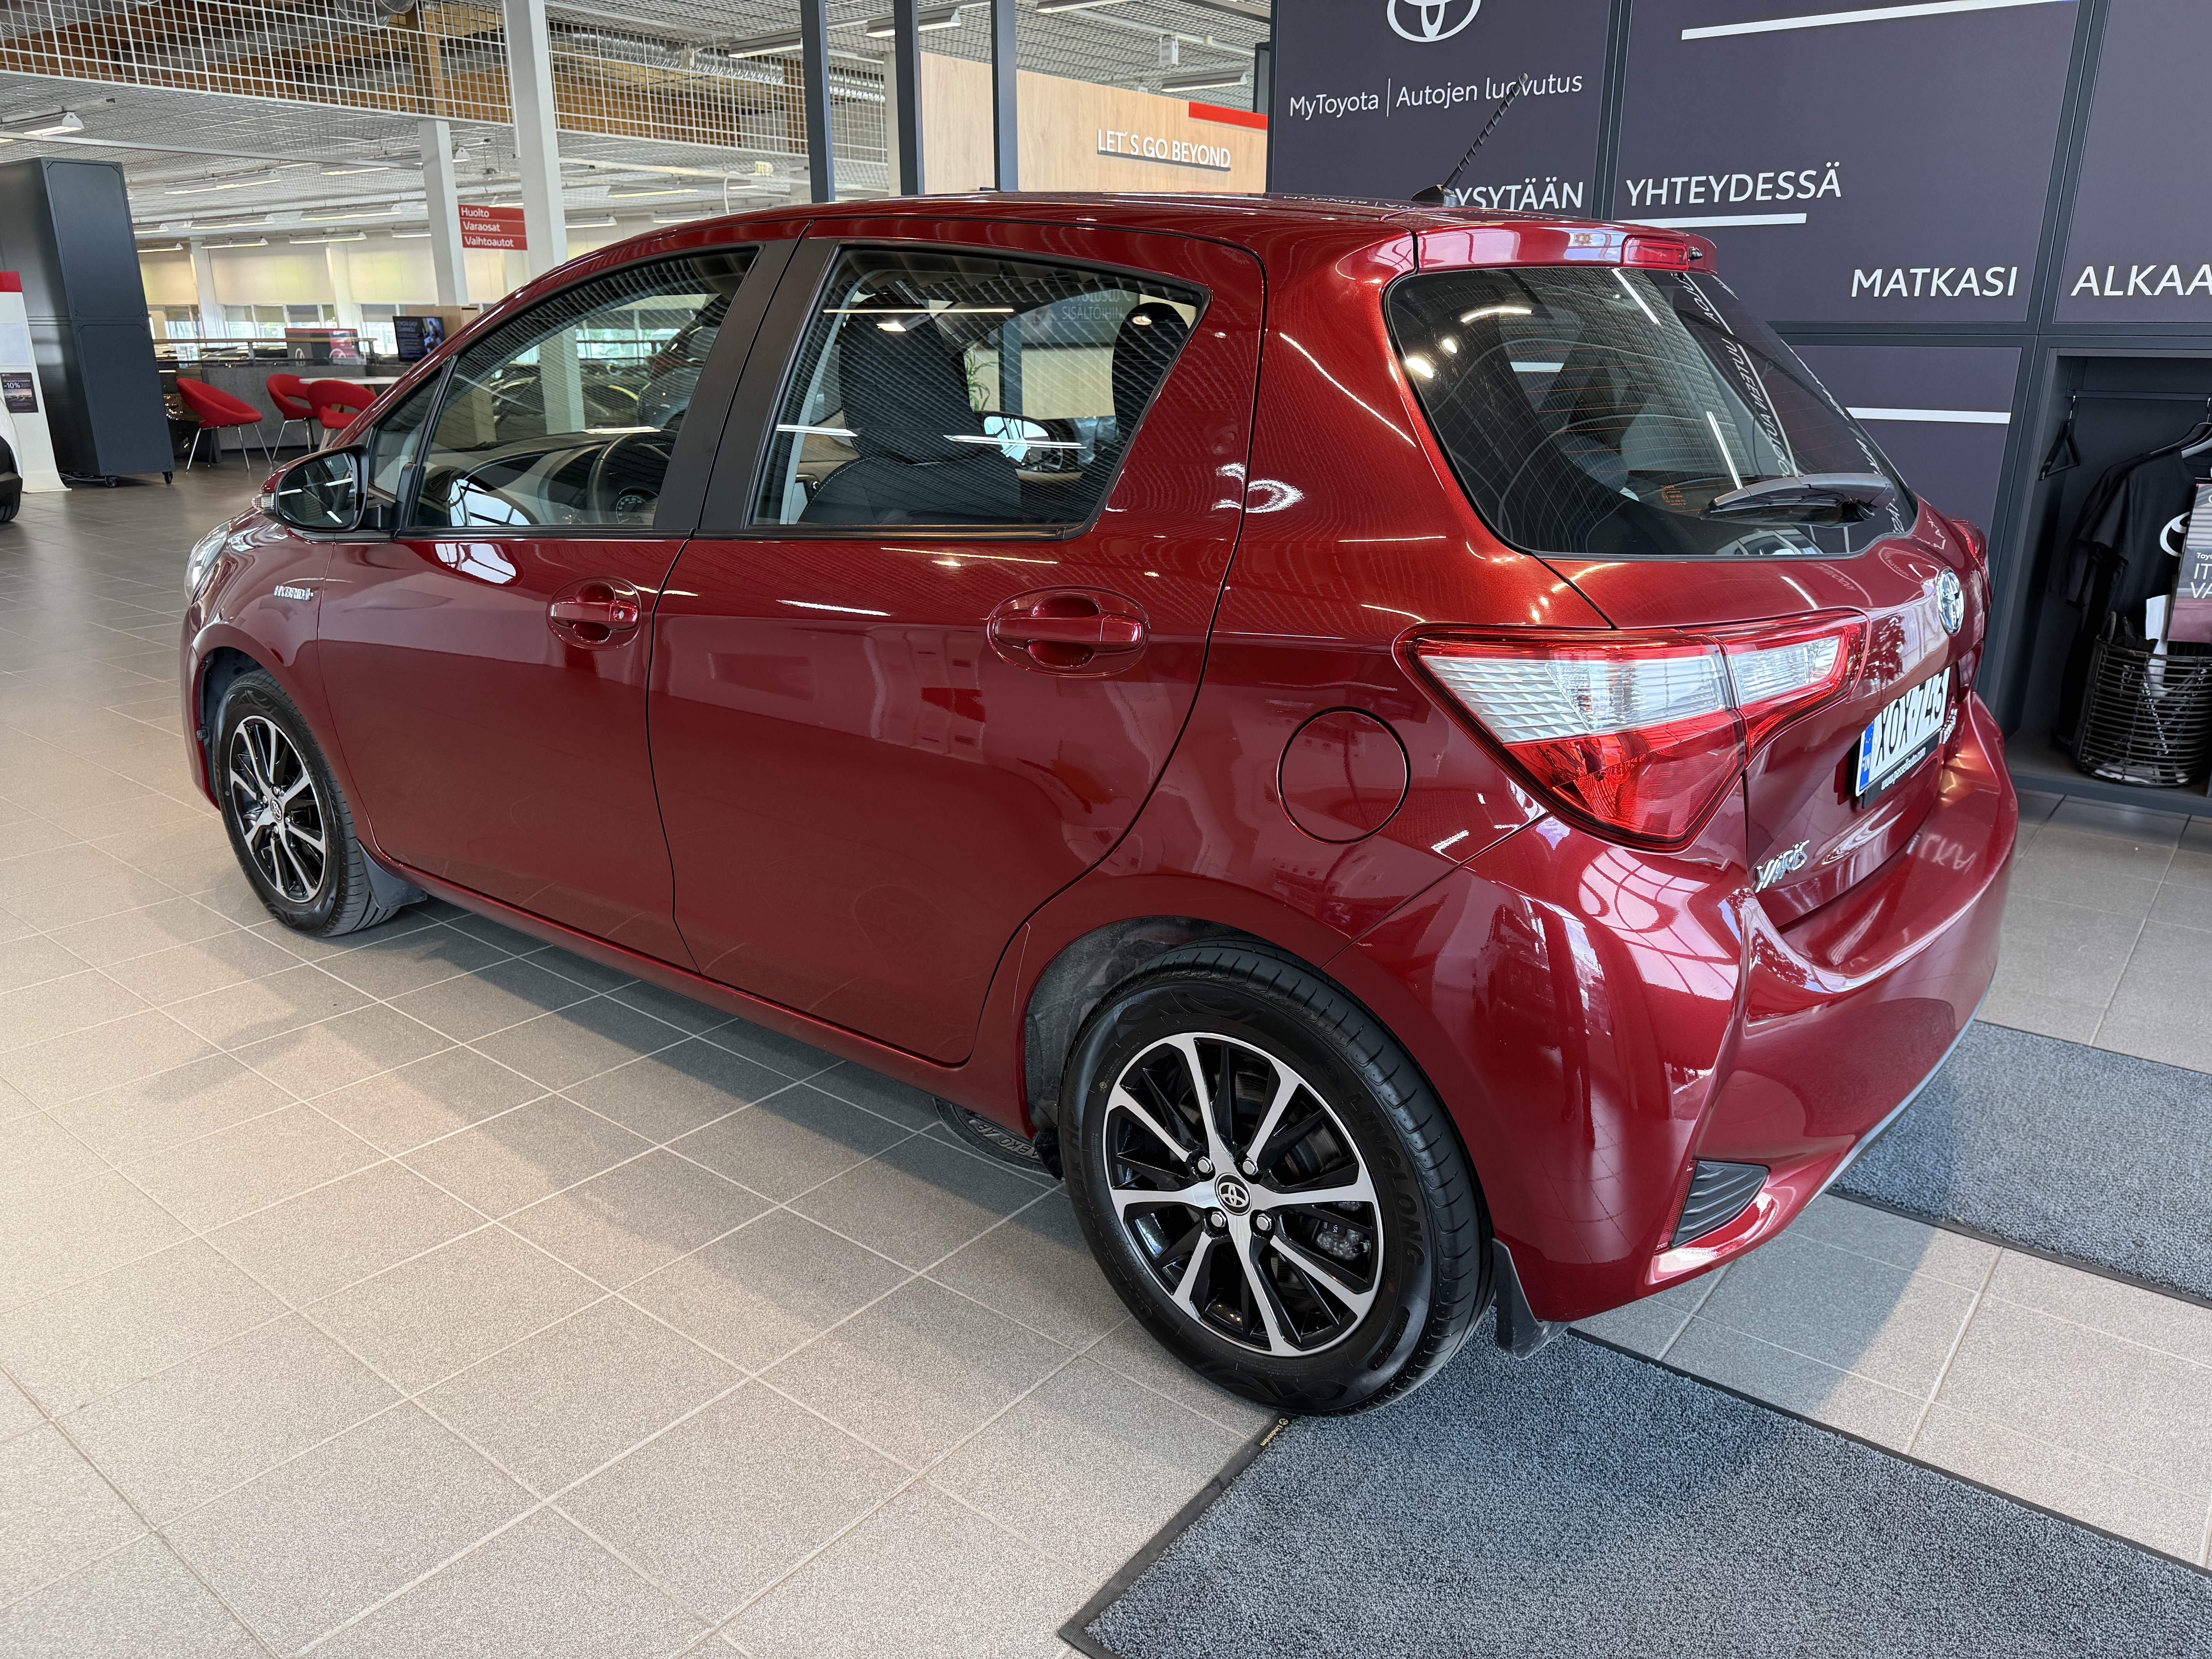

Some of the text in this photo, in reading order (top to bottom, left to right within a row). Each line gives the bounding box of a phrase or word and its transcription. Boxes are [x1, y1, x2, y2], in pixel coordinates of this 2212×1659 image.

[1290, 93, 1379, 120] MyToyota
[1396, 82, 1477, 108] Autojen
[1143, 137, 1168, 159] GO
[1172, 142, 1231, 168] BEYOND
[1455, 161, 1842, 210] YSYTÄÄN YHTEYDESSÄ
[461, 207, 489, 218] Huolto
[462, 221, 501, 232] Varaosat
[464, 235, 514, 247] Vaihtoautot
[1851, 264, 2212, 298] MATKASI ALKAA
[2193, 563, 2212, 580] IT
[274, 585, 305, 600] HYBRID
[1862, 752, 1872, 772] FIN
[1753, 839, 1810, 893] YARIS
[1349, 1089, 1426, 1266] LINGLONG
[1260, 1425, 1283, 1446] Lindström
